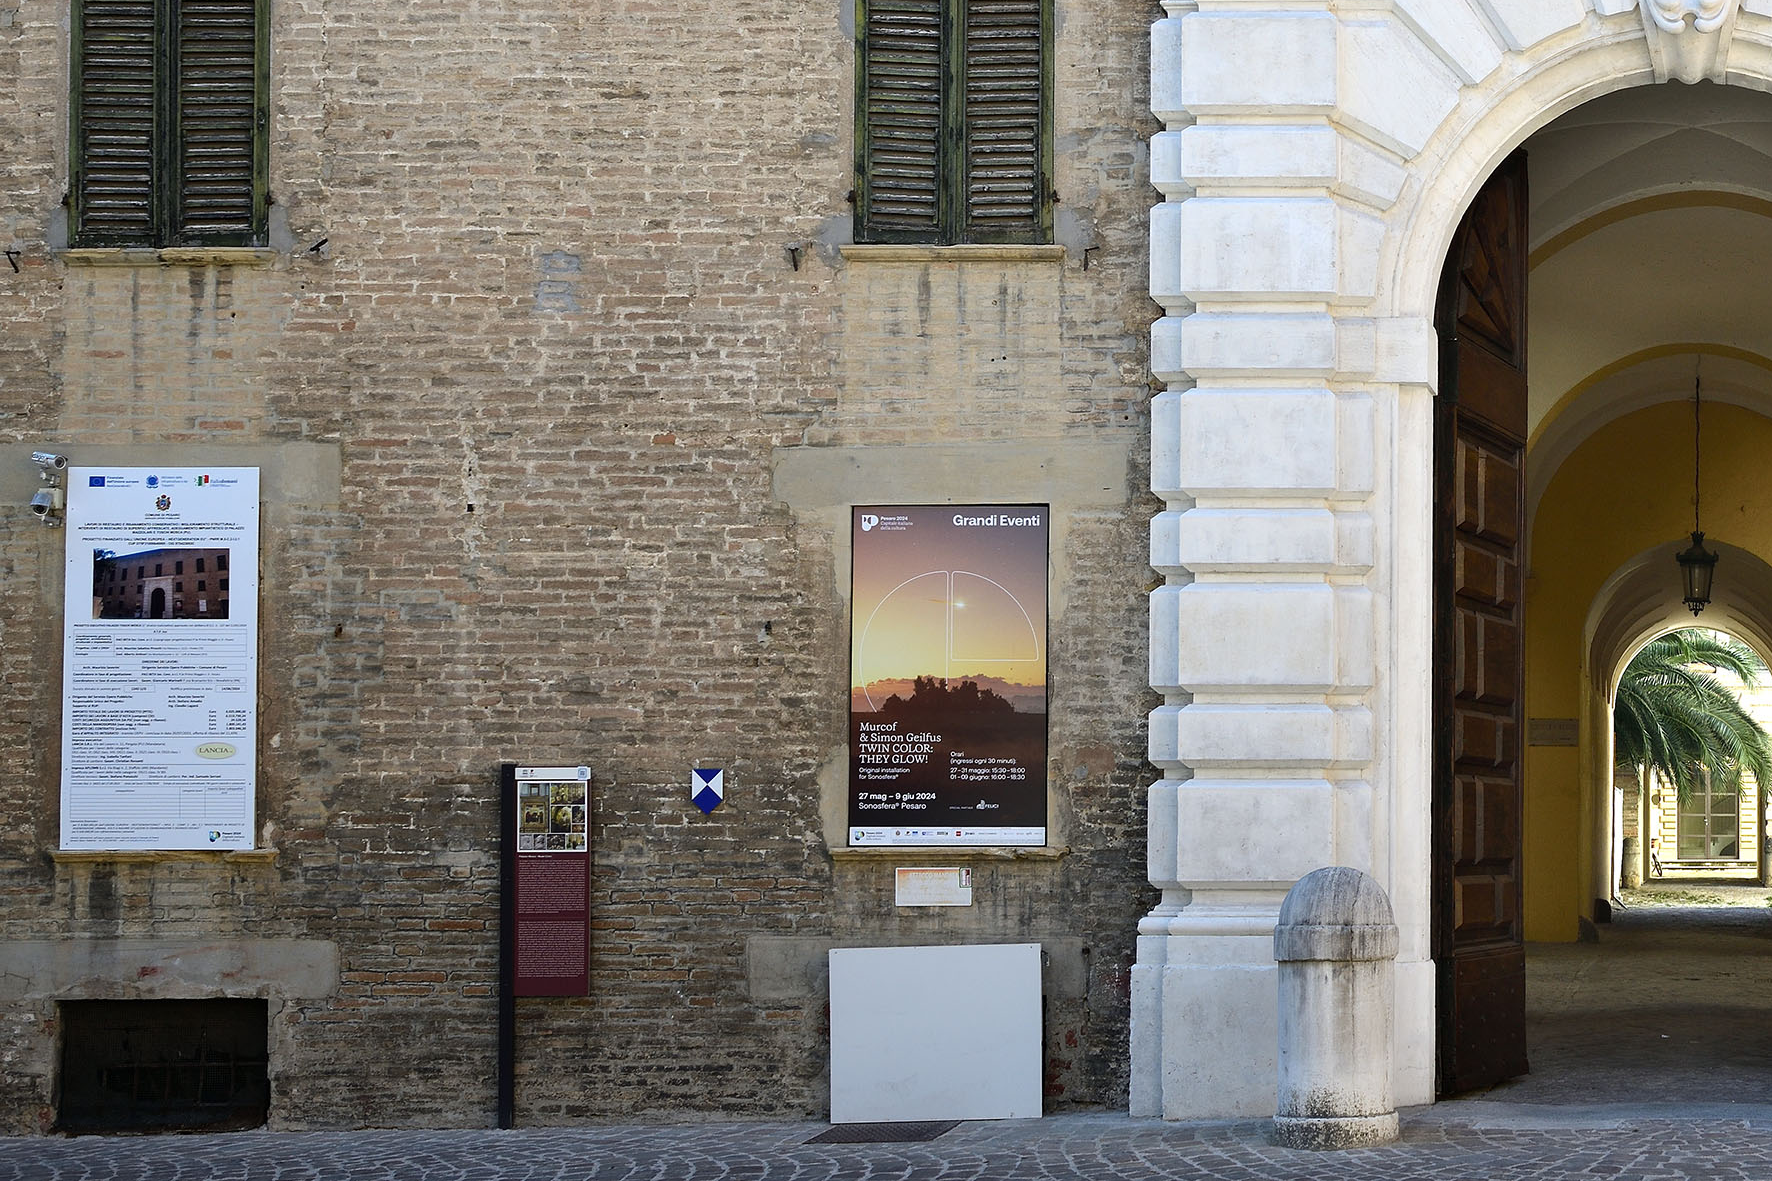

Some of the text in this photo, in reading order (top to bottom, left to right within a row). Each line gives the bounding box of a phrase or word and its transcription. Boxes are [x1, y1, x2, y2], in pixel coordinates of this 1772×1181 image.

[952, 514, 1040, 527] Grandi Eventi
[859, 722, 898, 731] Murcof
[860, 733, 942, 742] & Simon Geilfus
[859, 743, 933, 753] TWIN COLOR:
[859, 754, 928, 763] THEY GLOW!
[902, 793, 914, 801] giu
